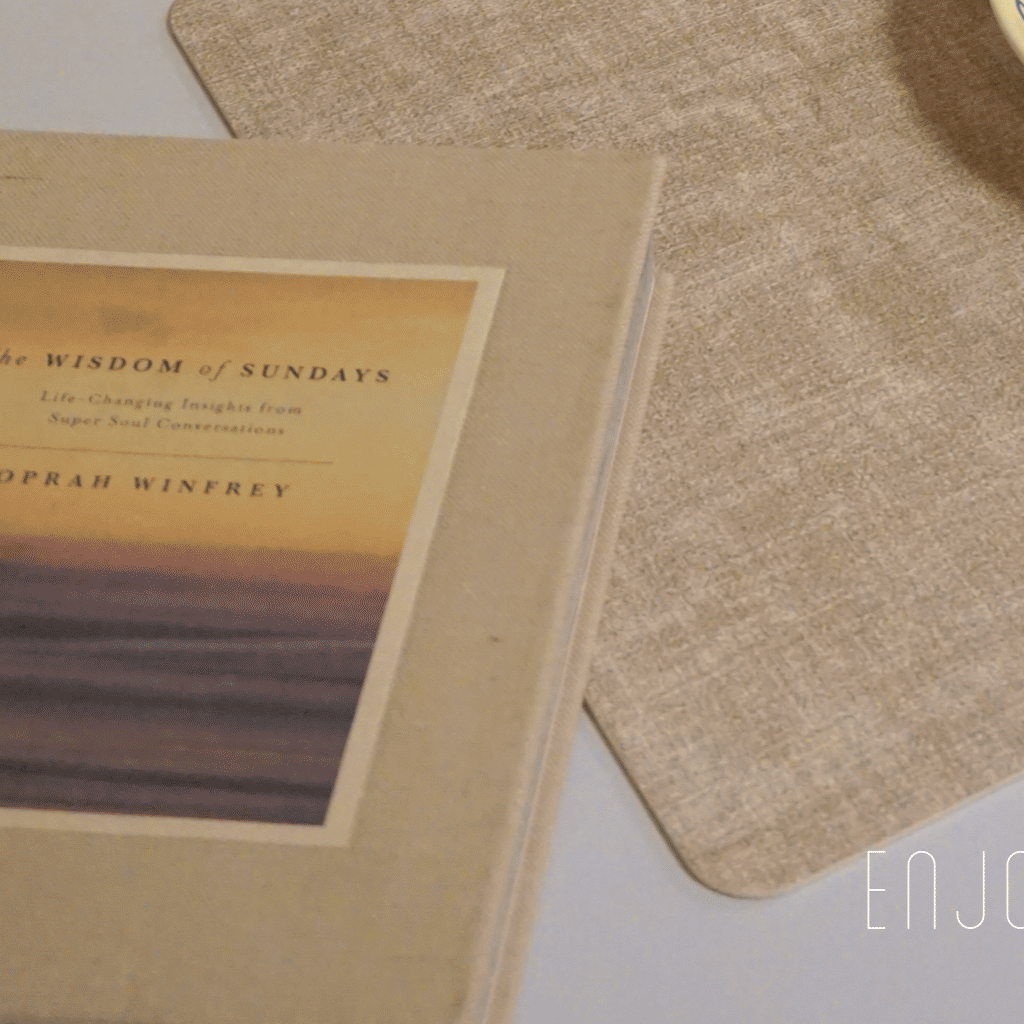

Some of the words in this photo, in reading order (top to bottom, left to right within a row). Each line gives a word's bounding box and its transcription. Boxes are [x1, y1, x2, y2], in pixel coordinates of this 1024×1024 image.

[0, 347, 28, 367] he
[46, 352, 184, 375] WISDOM
[198, 359, 232, 382] of
[239, 361, 391, 385] SUNDAYS
[39, 389, 174, 412] Life-Changing
[180, 397, 252, 416] Insights
[258, 400, 304, 416] from
[48, 411, 103, 430] Super
[107, 413, 151, 430] Soul
[156, 416, 285, 437] Conversations
[0, 468, 112, 490] OPRAH
[133, 476, 291, 499] WINFREY
